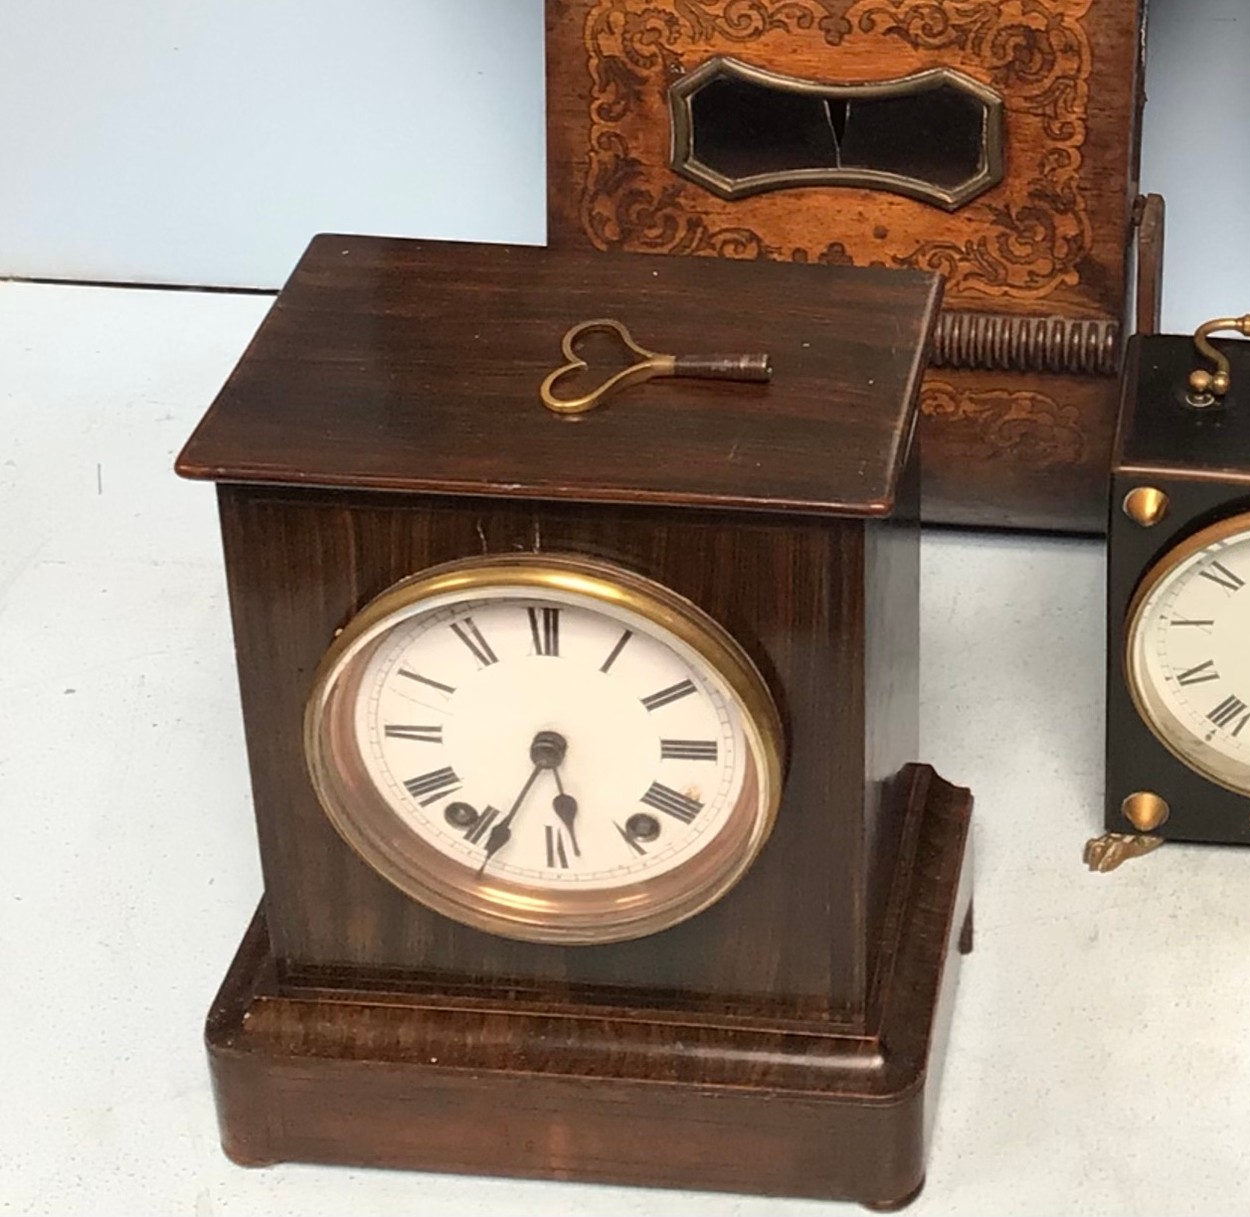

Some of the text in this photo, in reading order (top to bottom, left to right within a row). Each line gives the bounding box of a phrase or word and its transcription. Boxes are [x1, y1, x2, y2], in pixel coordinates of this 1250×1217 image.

[1197, 559, 1247, 598] XI
[449, 616, 500, 671] XI
[527, 606, 565, 658] XII
[1173, 659, 1221, 687] IX
[640, 678, 699, 712] II
[384, 724, 443, 744] IX
[659, 738, 719, 762] III
[402, 766, 463, 808] VIII
[544, 824, 570, 870] VI
